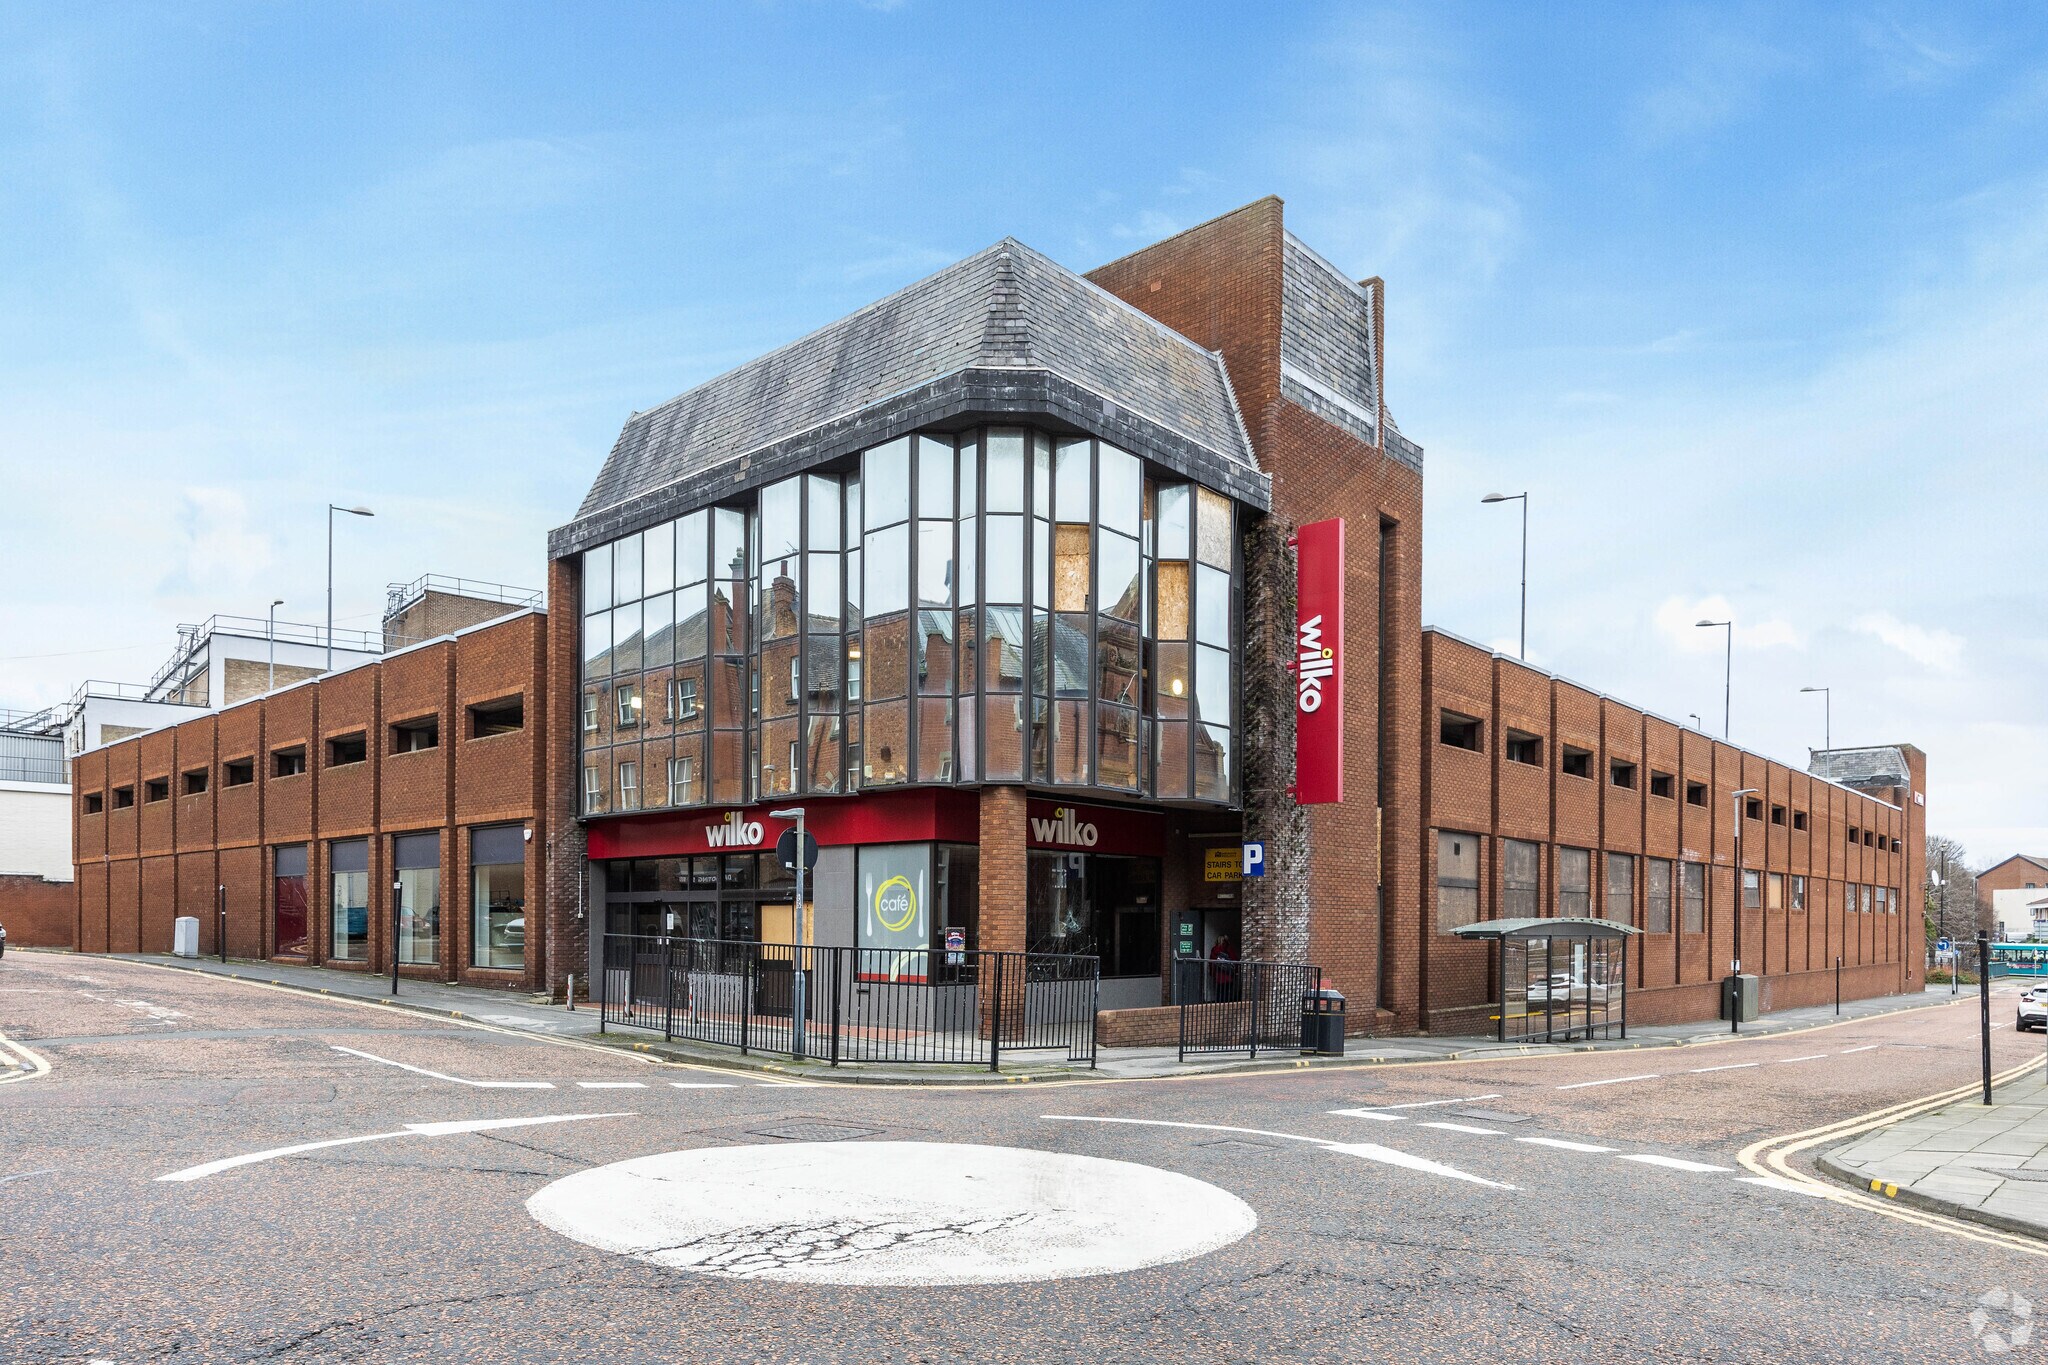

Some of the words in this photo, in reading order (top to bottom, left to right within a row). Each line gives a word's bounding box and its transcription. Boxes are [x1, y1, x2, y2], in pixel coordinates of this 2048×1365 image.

[1300, 614, 1334, 713] wilko
[705, 811, 765, 848] wilko
[1030, 807, 1099, 847] wilko
[1206, 861, 1232, 869] STAIRS
[1243, 844, 1263, 874] P
[1206, 871, 1222, 880] CAR
[1224, 871, 1244, 879] PARK
[880, 894, 909, 911] café
